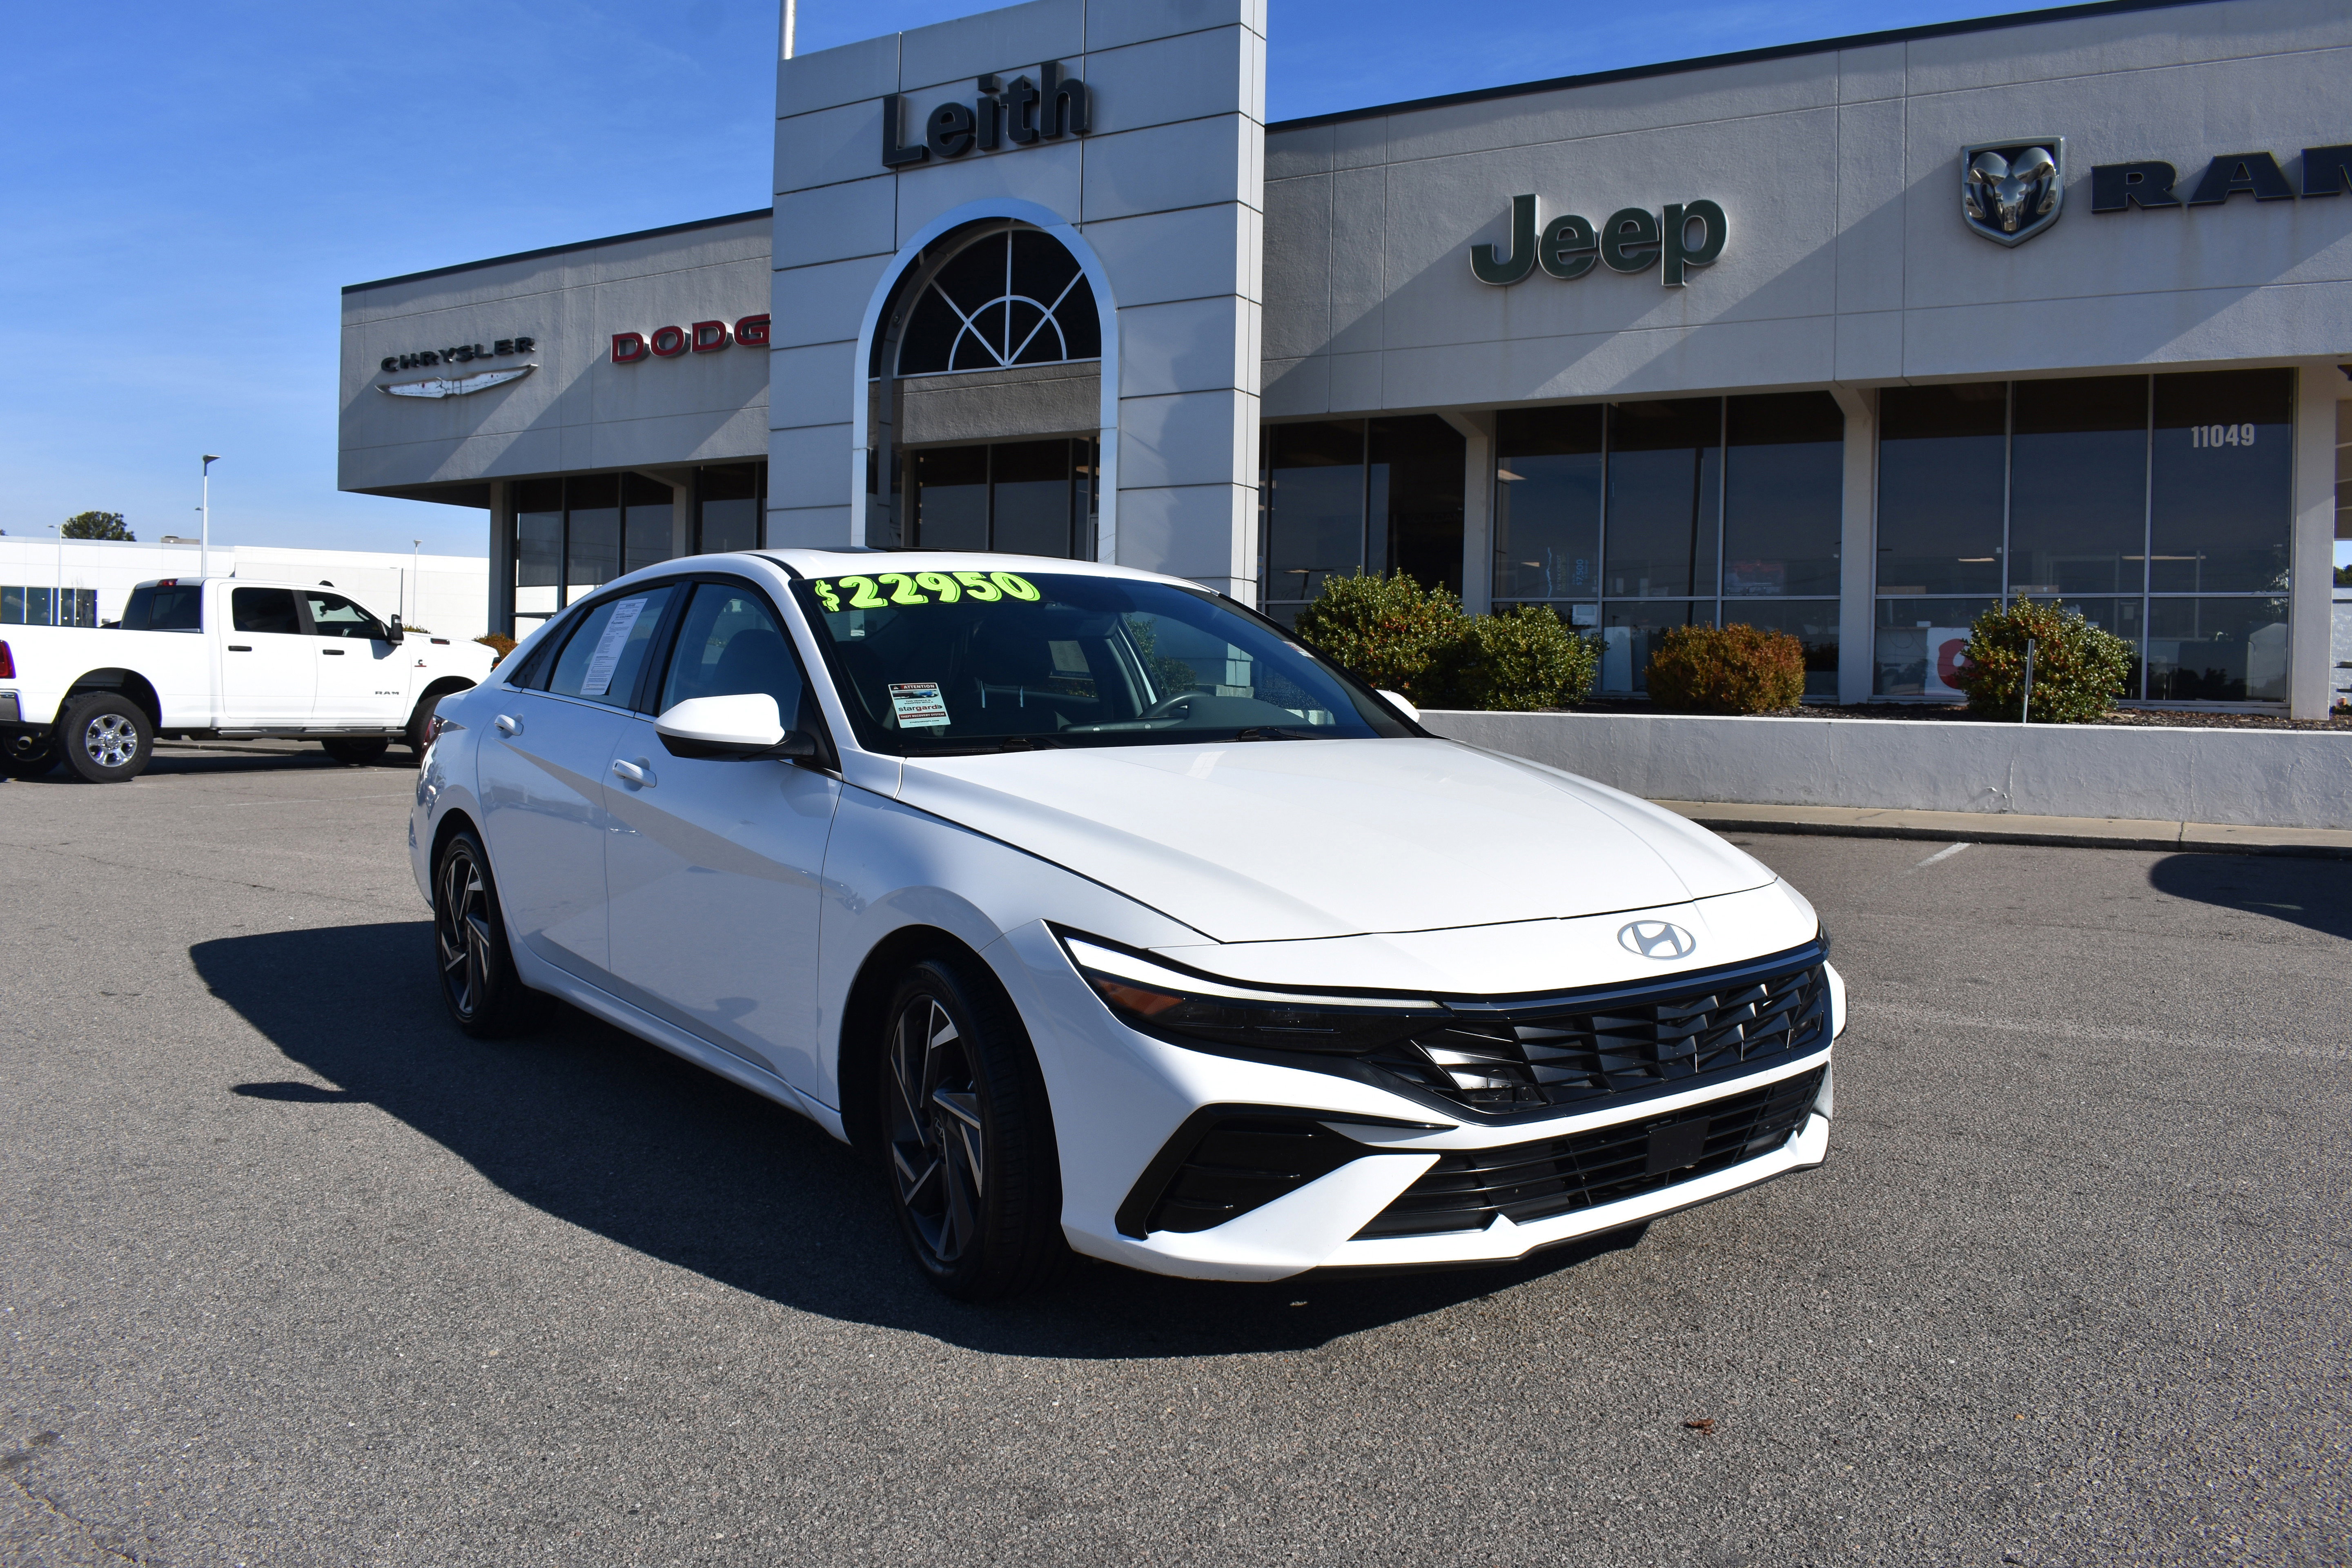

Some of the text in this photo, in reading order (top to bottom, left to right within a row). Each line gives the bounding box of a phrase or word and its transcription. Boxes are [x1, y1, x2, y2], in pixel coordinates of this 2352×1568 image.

[882, 60, 1092, 168] Leith
[1470, 194, 1730, 288] Jeep
[381, 336, 535, 372] CHRYSLER
[610, 313, 771, 363] DODG
[2191, 423, 2255, 448] 11049
[815, 572, 1040, 612] $22950
[1576, 559, 1584, 585] $7,500
